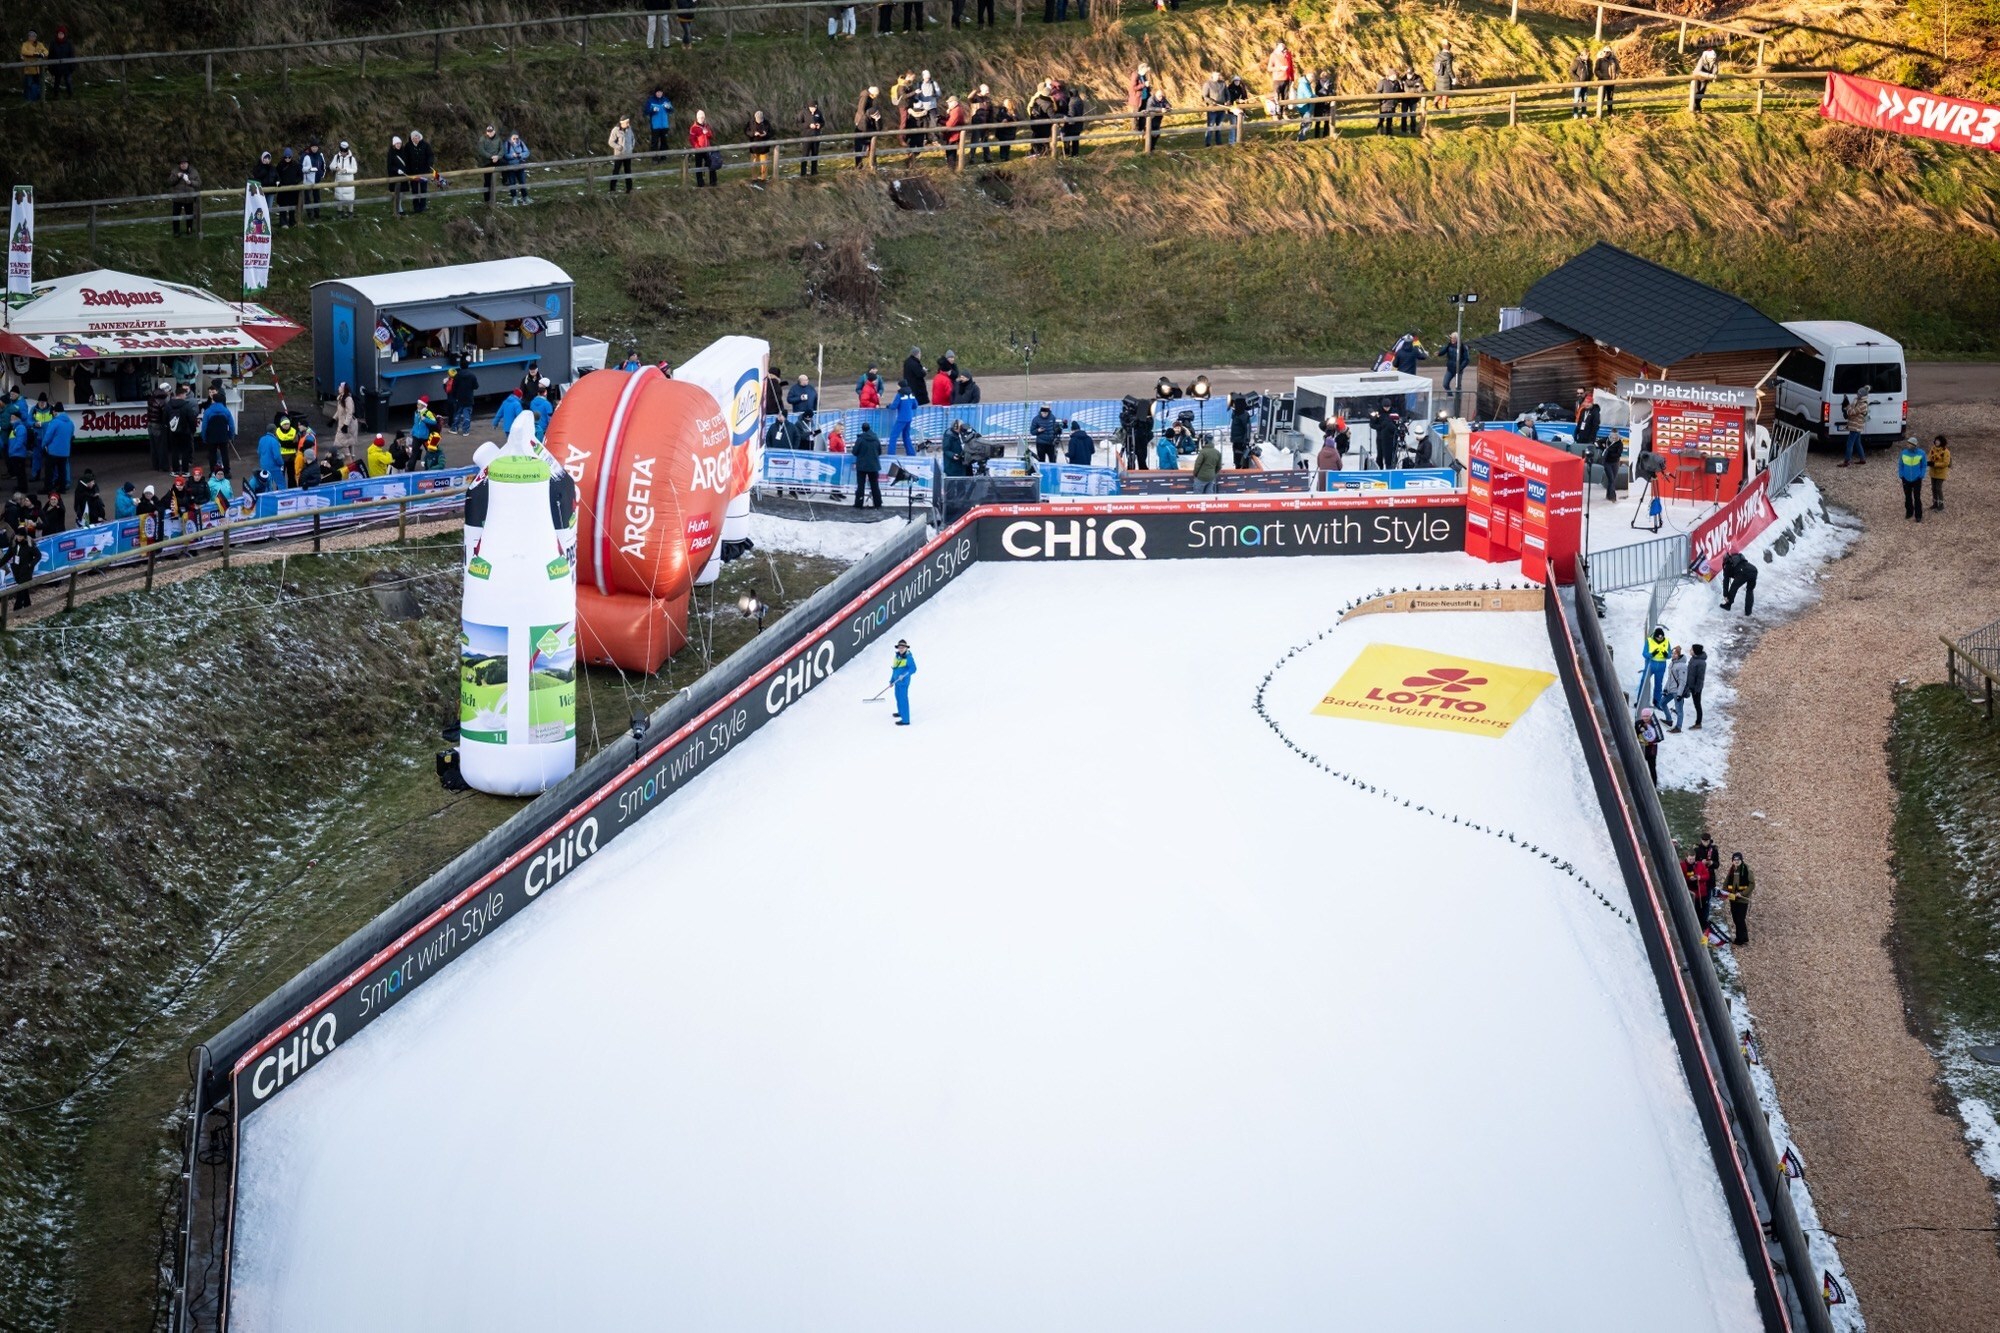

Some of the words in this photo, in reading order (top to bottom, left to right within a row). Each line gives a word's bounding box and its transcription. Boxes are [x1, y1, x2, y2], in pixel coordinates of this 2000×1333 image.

[1903, 96, 2000, 145] SWR3
[79, 288, 164, 308] Rothaus
[89, 320, 166, 330] TANNENZÄPFLE
[113, 337, 240, 349] Rothaus
[80, 410, 148, 434] Rothaus
[1505, 452, 1549, 476] VIESSMANN
[1187, 502, 1229, 512] VIESSMANN
[1281, 500, 1323, 510] VIESSMANN
[1375, 497, 1417, 507] VIESSMANN
[1550, 490, 1582, 500] VIESSMANN
[687, 518, 709, 534] Huhn
[1001, 517, 1147, 559] CHiQ
[1187, 519, 1285, 548] Smart
[1293, 515, 1361, 545] with
[1373, 512, 1450, 550] Style
[1365, 687, 1487, 714] LOTTO
[1321, 696, 1511, 730] Baden-Württemberg
[252, 1012, 337, 1099] CHiQ
[359, 955, 414, 1017] Smart
[418, 924, 456, 971] with
[461, 893, 504, 942] Style
[524, 816, 599, 897] CHiQ
[618, 764, 667, 822] Smart
[671, 737, 704, 782] with
[709, 709, 747, 754] Style
[766, 640, 835, 714] CHiQ
[852, 591, 897, 646] Smart
[900, 564, 932, 608] with
[935, 538, 971, 582] Style
